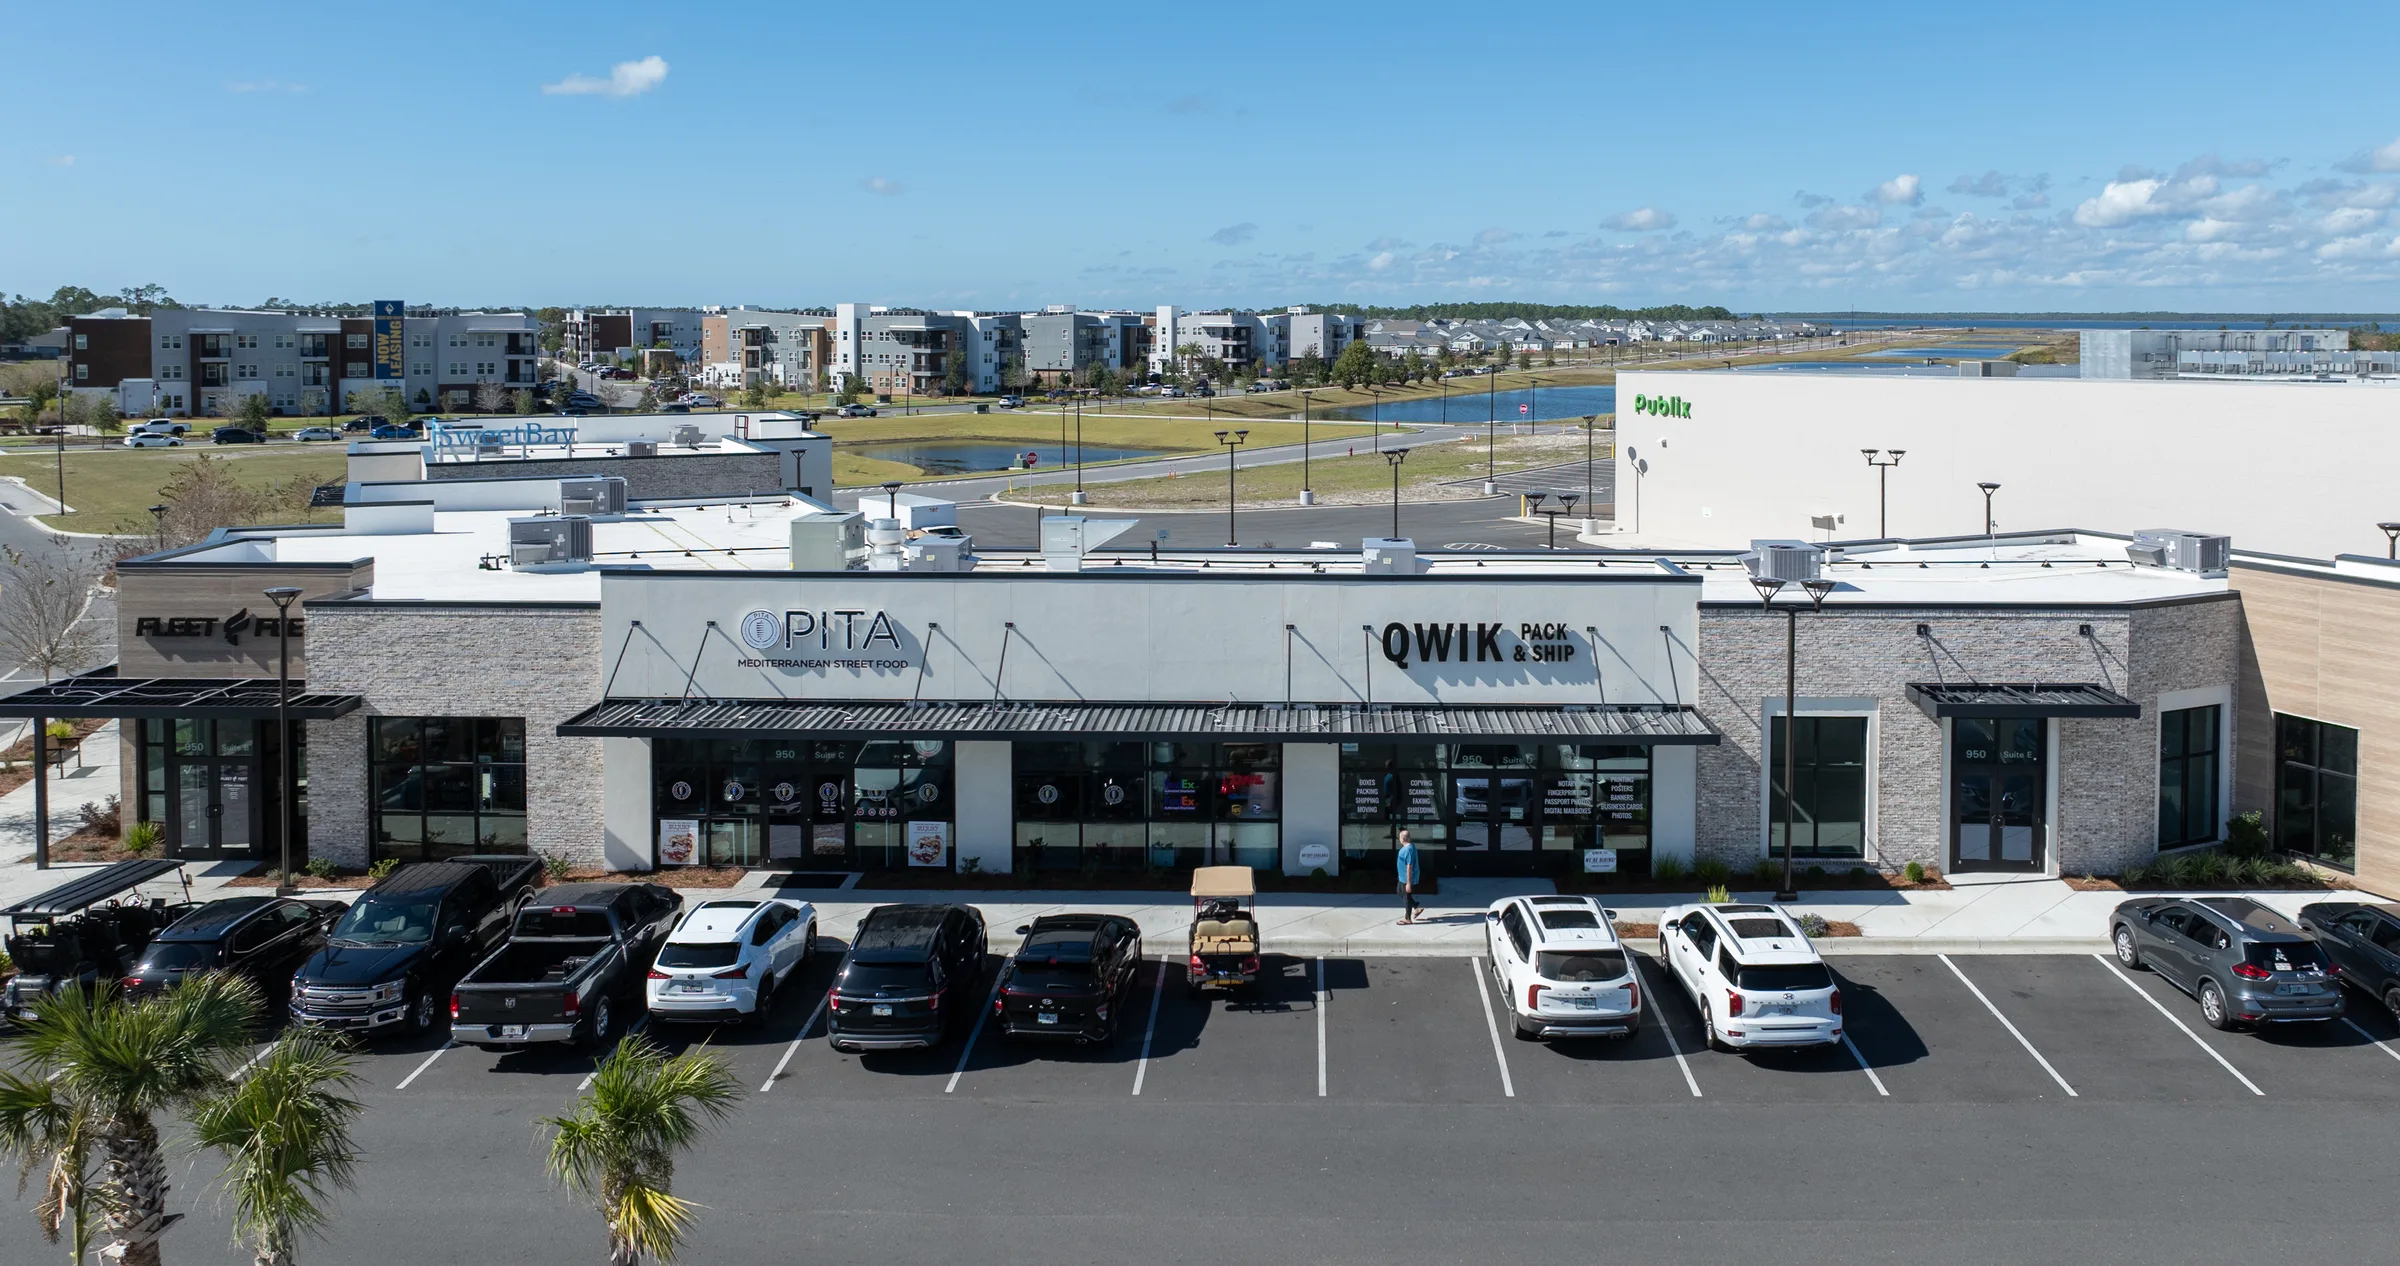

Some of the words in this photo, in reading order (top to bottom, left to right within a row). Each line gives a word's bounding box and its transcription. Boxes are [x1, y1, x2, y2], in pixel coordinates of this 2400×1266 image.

[377, 333, 390, 364] NOW
[390, 320, 403, 377] LEASING
[1635, 394, 1691, 419] Publix
[439, 423, 575, 449] SweetBay
[136, 617, 219, 637] FLEET
[784, 608, 902, 651] PITA
[1521, 623, 1567, 640] PACK
[1382, 622, 1503, 669] QWIK
[1513, 644, 1526, 662] &
[1532, 644, 1574, 662] SHIP
[738, 659, 831, 668] MEDITERRANEAN
[834, 660, 873, 669] STREET
[877, 660, 908, 669] FOOD
[184, 742, 204, 751] 950
[221, 744, 242, 752] Suite
[775, 750, 795, 759] 950
[815, 751, 836, 759] Suite
[838, 751, 845, 759] C
[1966, 749, 1986, 759] 950
[1462, 755, 1482, 764] 950
[1502, 756, 1523, 764] Suite
